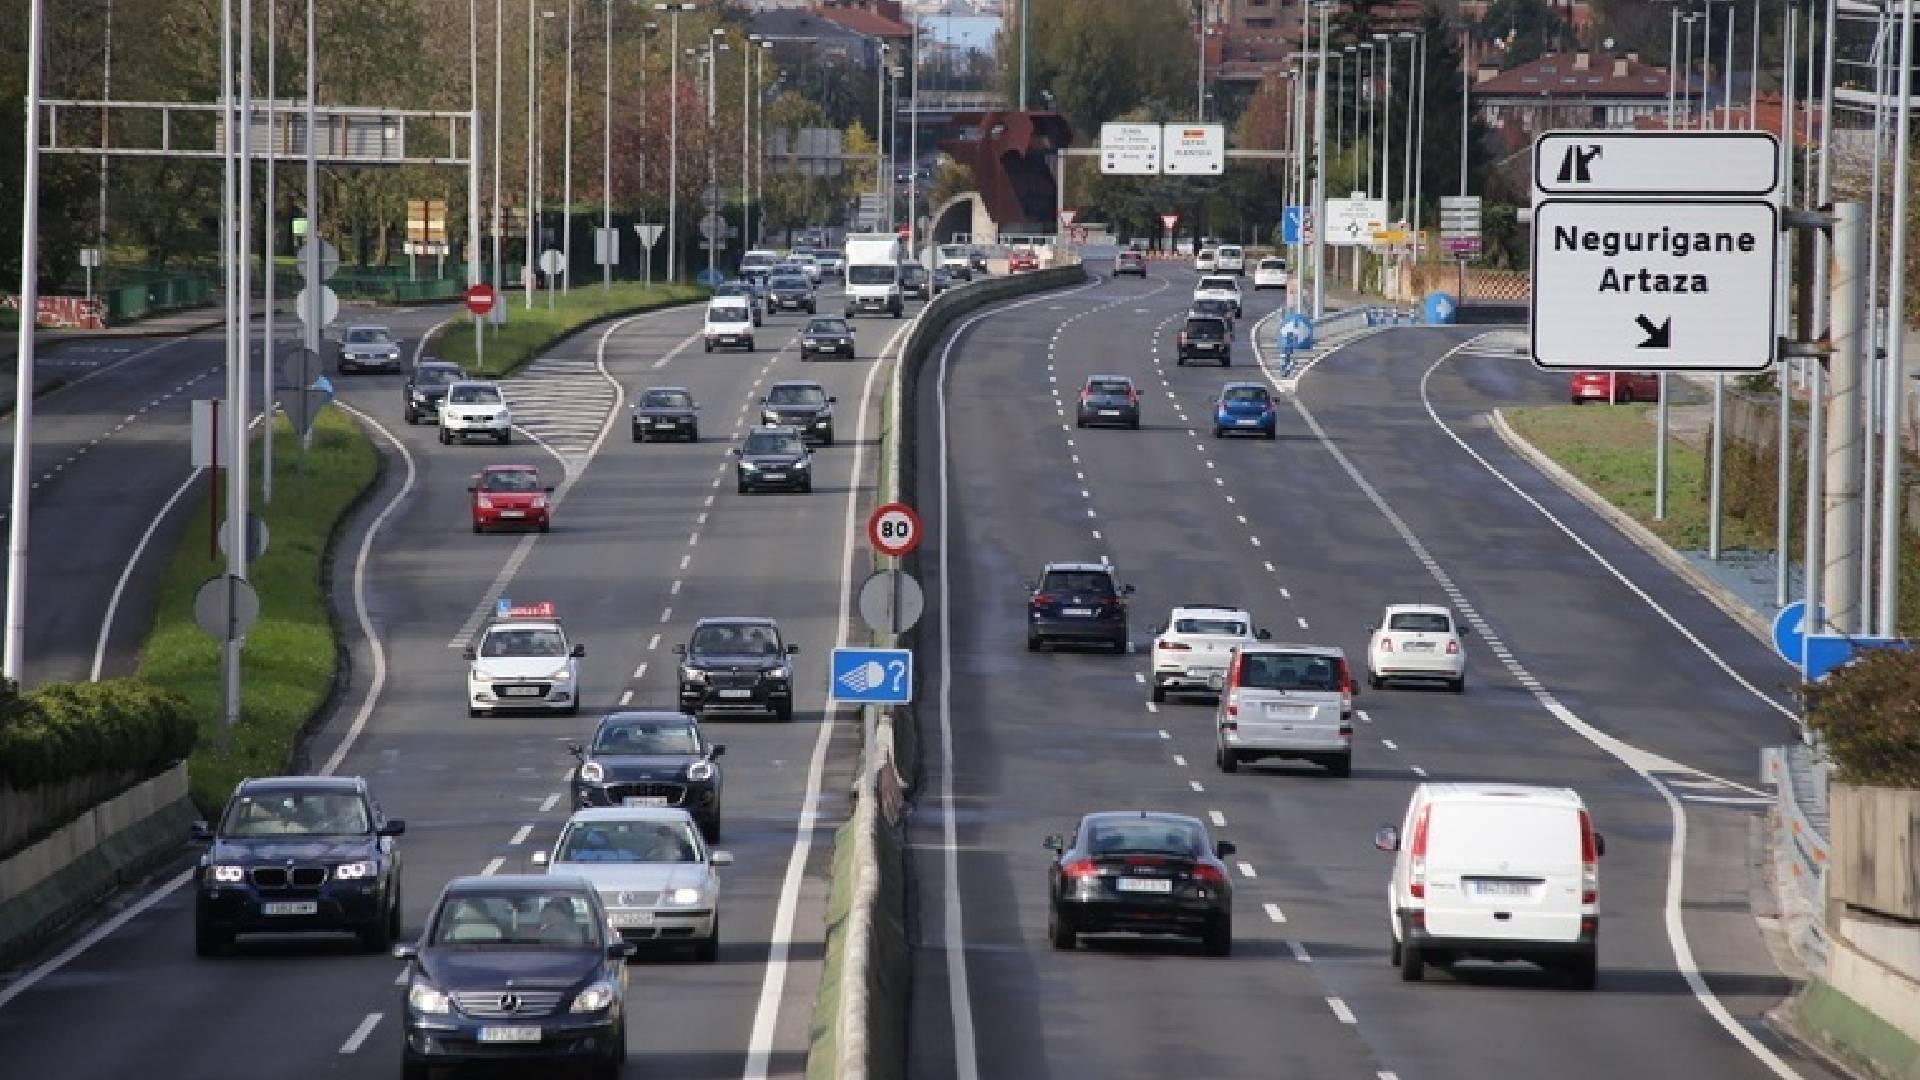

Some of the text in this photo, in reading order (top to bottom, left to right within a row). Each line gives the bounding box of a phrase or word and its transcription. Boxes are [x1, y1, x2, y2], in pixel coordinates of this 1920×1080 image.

[1555, 225, 1756, 257] Negurigane
[1599, 267, 1710, 294] Artaza
[881, 520, 909, 538] 80
